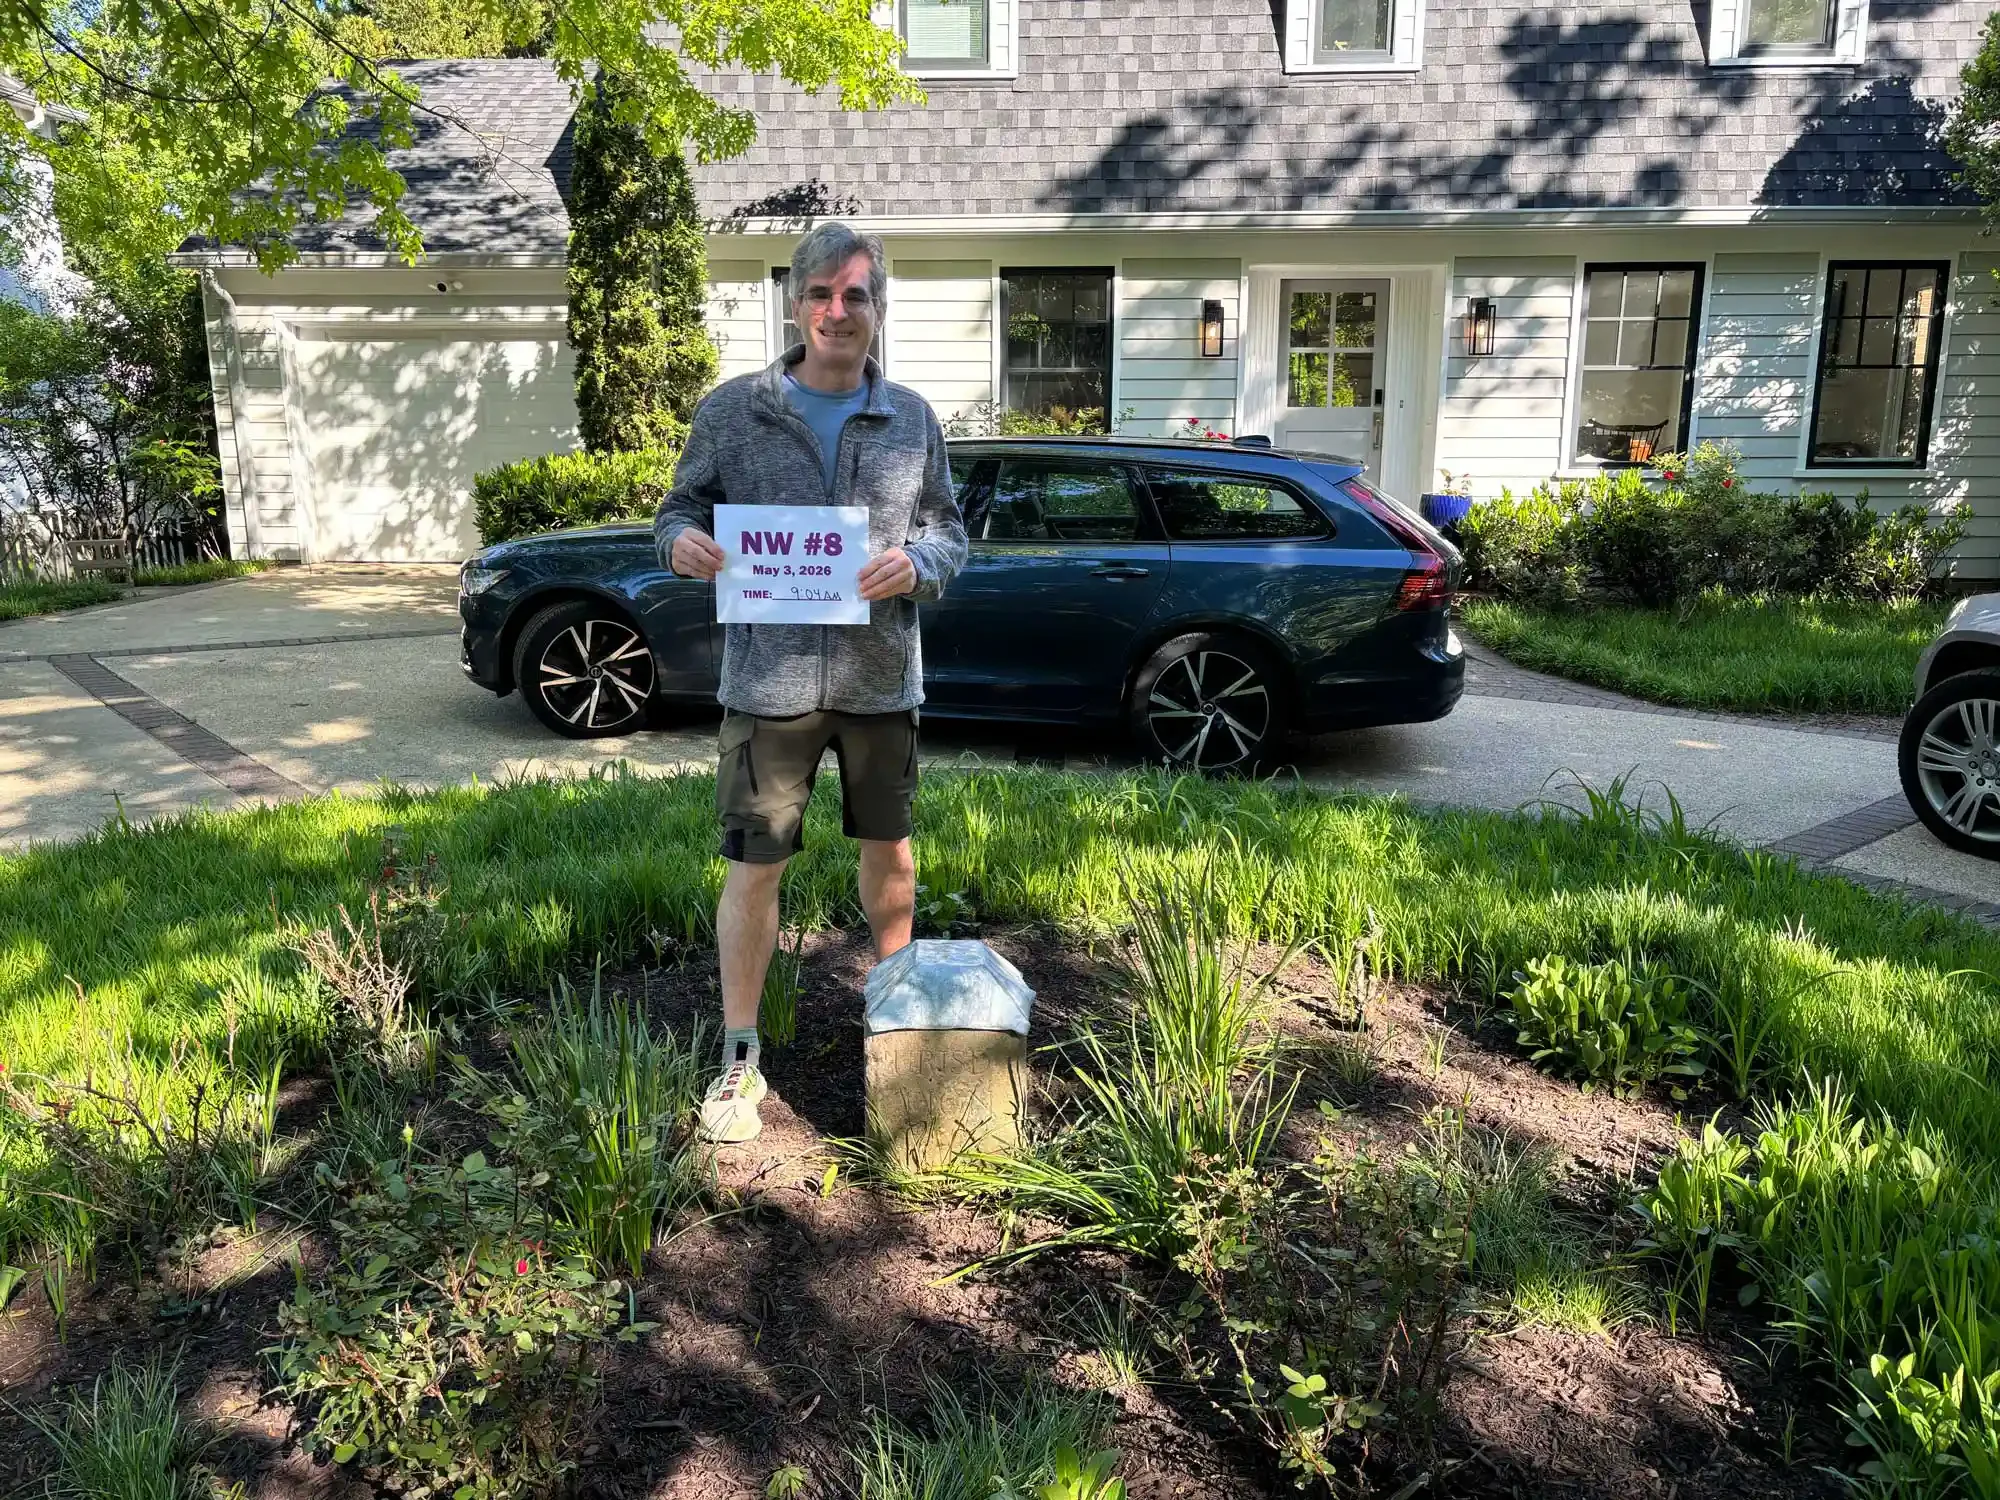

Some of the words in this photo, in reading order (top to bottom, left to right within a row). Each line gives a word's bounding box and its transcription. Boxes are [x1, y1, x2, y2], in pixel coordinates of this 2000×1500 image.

[741, 531, 794, 556] NW
[803, 532, 843, 556] #8
[753, 565, 780, 577] May
[783, 566, 796, 577] 3,
[799, 566, 832, 576] 2026
[742, 590, 773, 599] TIME:
